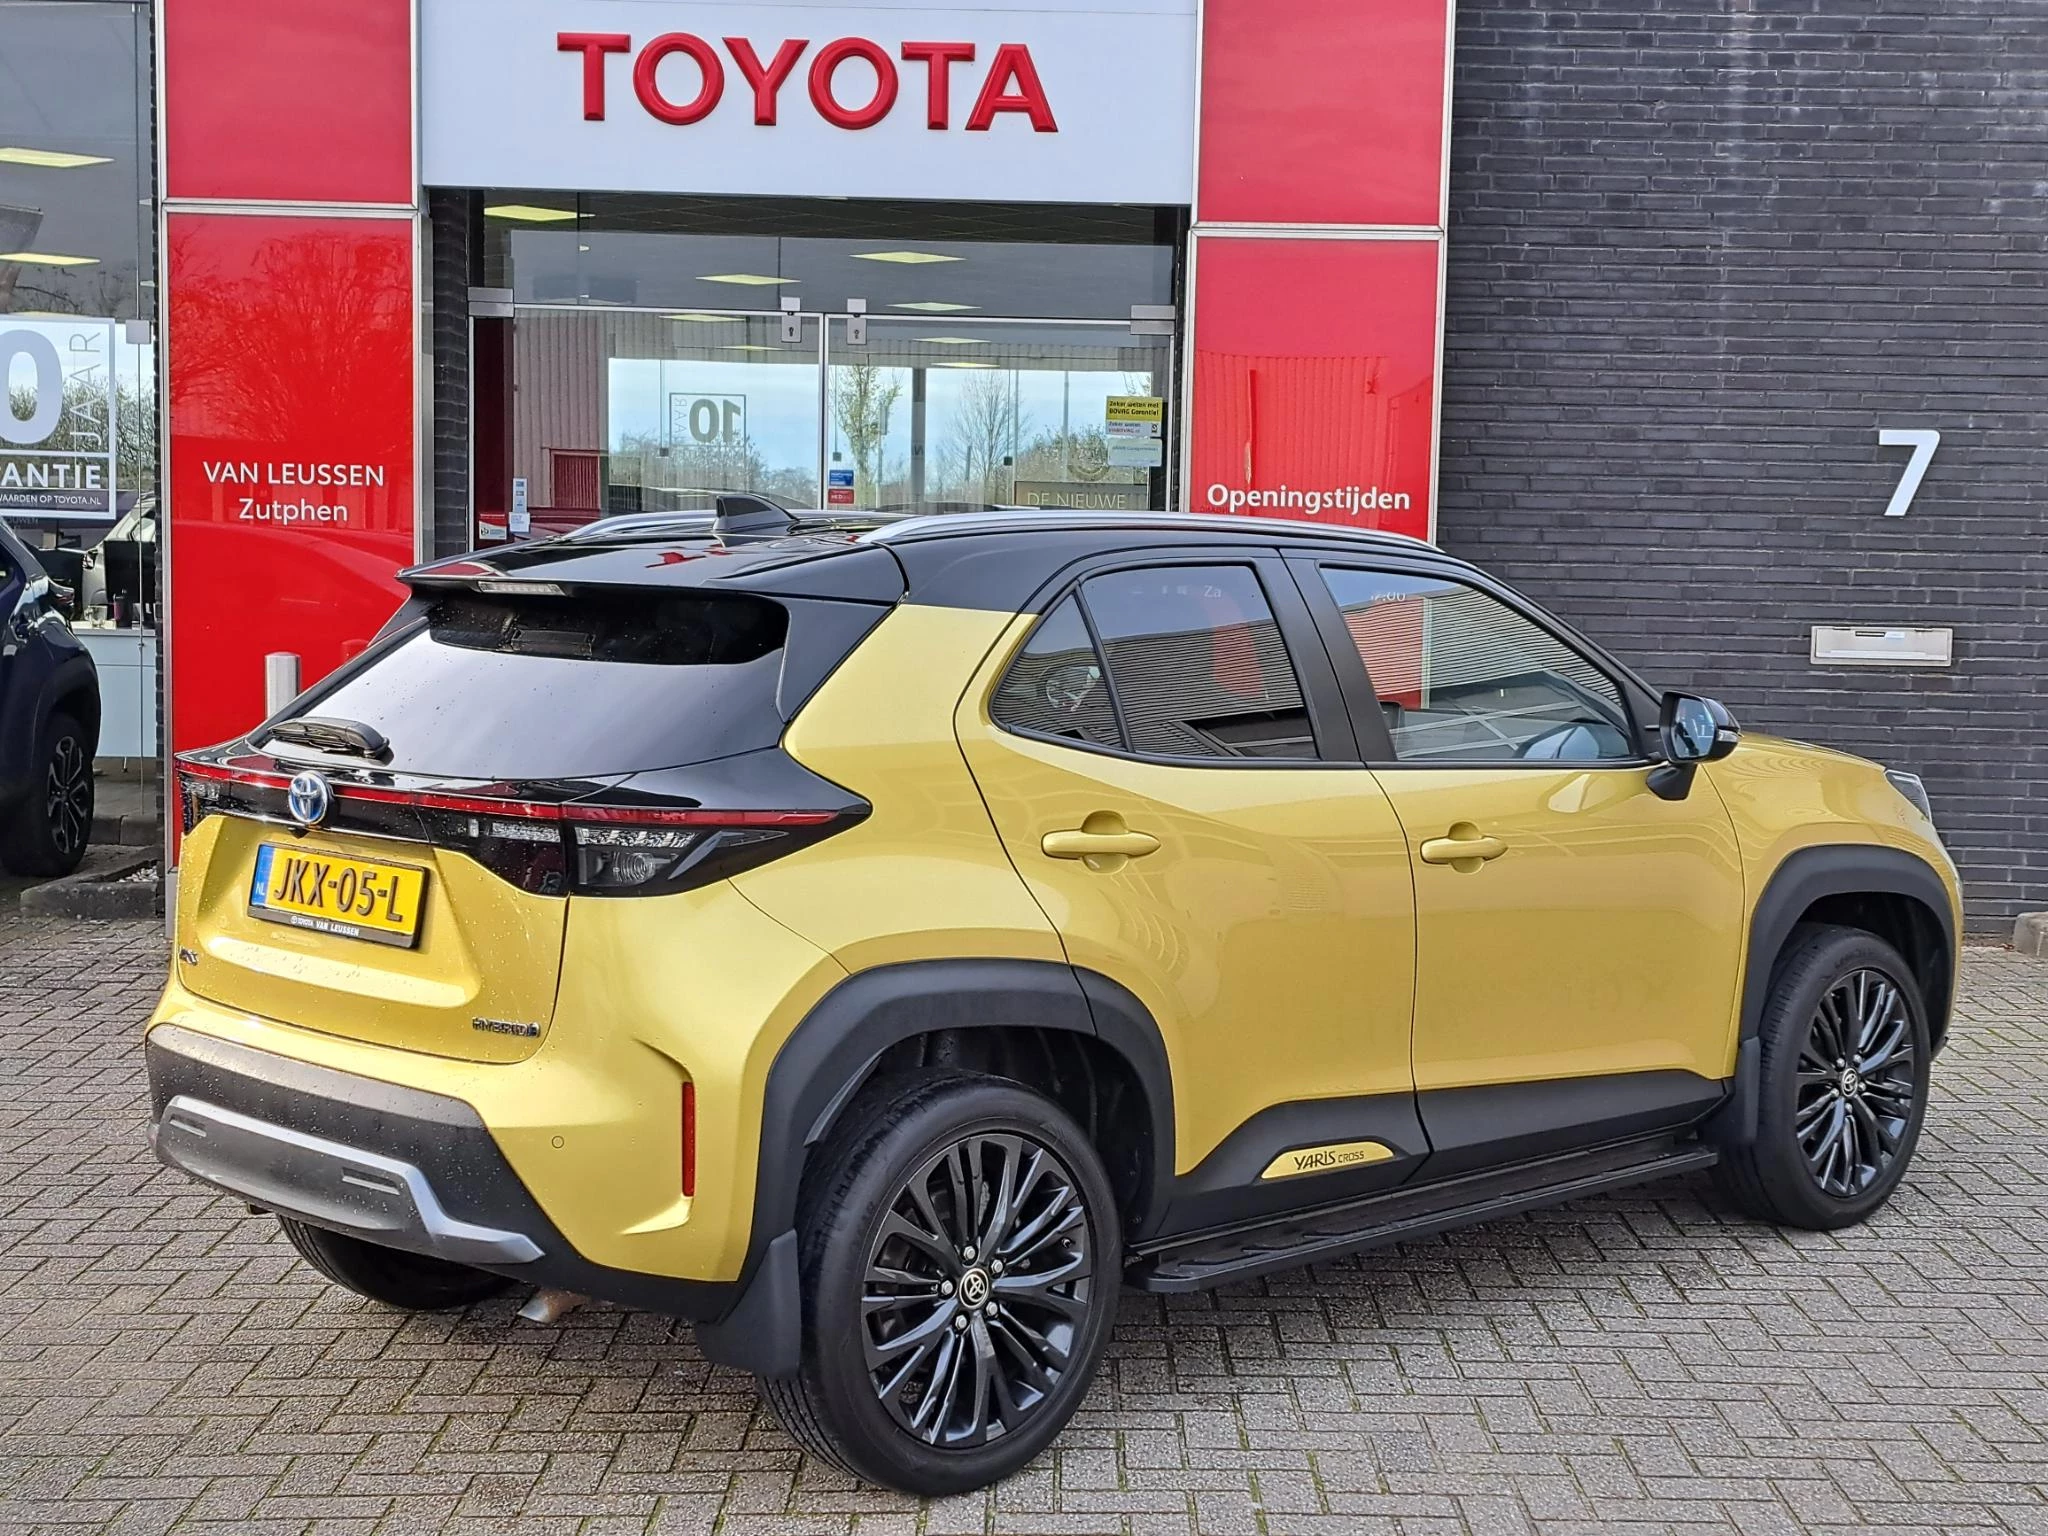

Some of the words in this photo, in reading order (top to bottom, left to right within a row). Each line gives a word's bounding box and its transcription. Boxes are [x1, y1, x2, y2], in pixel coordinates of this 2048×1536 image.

[557, 31, 1059, 133] TOYOTA
[69, 332, 102, 446] JAAR
[0, 462, 101, 489] ANTIE
[202, 461, 258, 484] VAN
[267, 462, 384, 487] LEUSSEN
[1878, 429, 1941, 516] 7
[39, 495, 53, 503] OP
[54, 496, 102, 505] TOYOTA.NL
[239, 498, 348, 526] Zutphen
[1056, 493, 1126, 510] NIEUWE
[1207, 483, 1411, 516] Openingstijden
[1203, 584, 1222, 598] Za
[255, 881, 265, 895] NL
[274, 857, 404, 924] JKX-05-L
[316, 919, 329, 931] VAN
[330, 922, 360, 937] LEUSSEN
[472, 1016, 529, 1037] HYBRID
[1294, 1150, 1337, 1171] YARIS
[1337, 1150, 1365, 1164] CROSS
